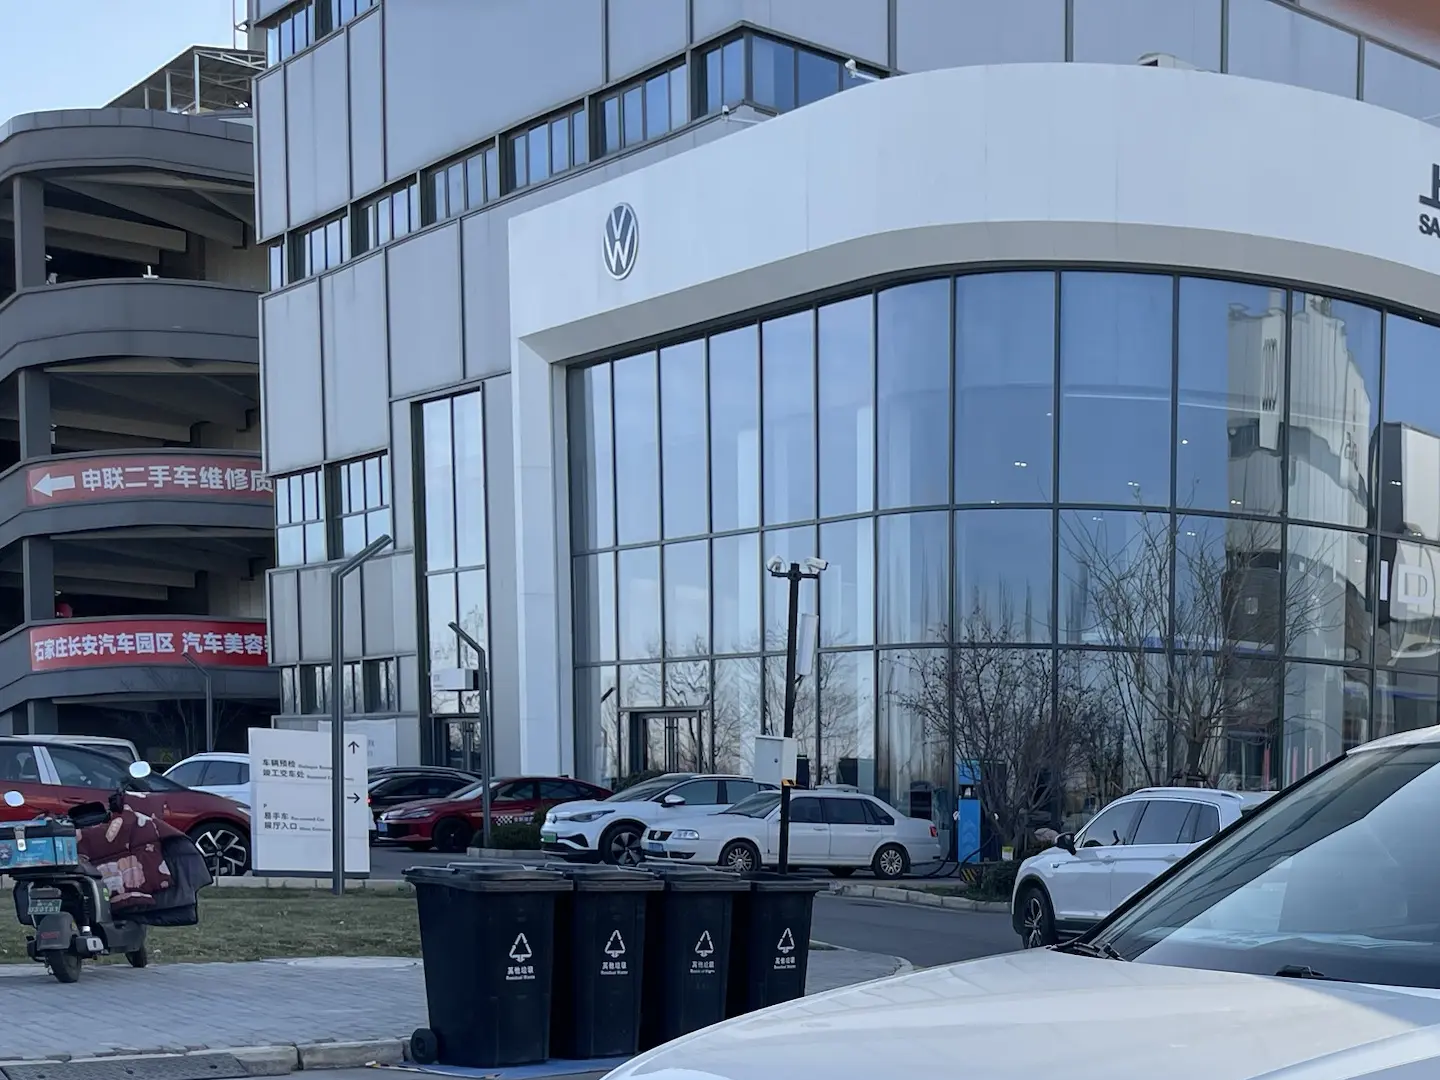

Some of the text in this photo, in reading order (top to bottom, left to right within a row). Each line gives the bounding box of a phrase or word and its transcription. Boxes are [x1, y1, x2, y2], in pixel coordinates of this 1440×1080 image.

[34, 631, 269, 662] 石家庄长安汽车园区 汽车美容
